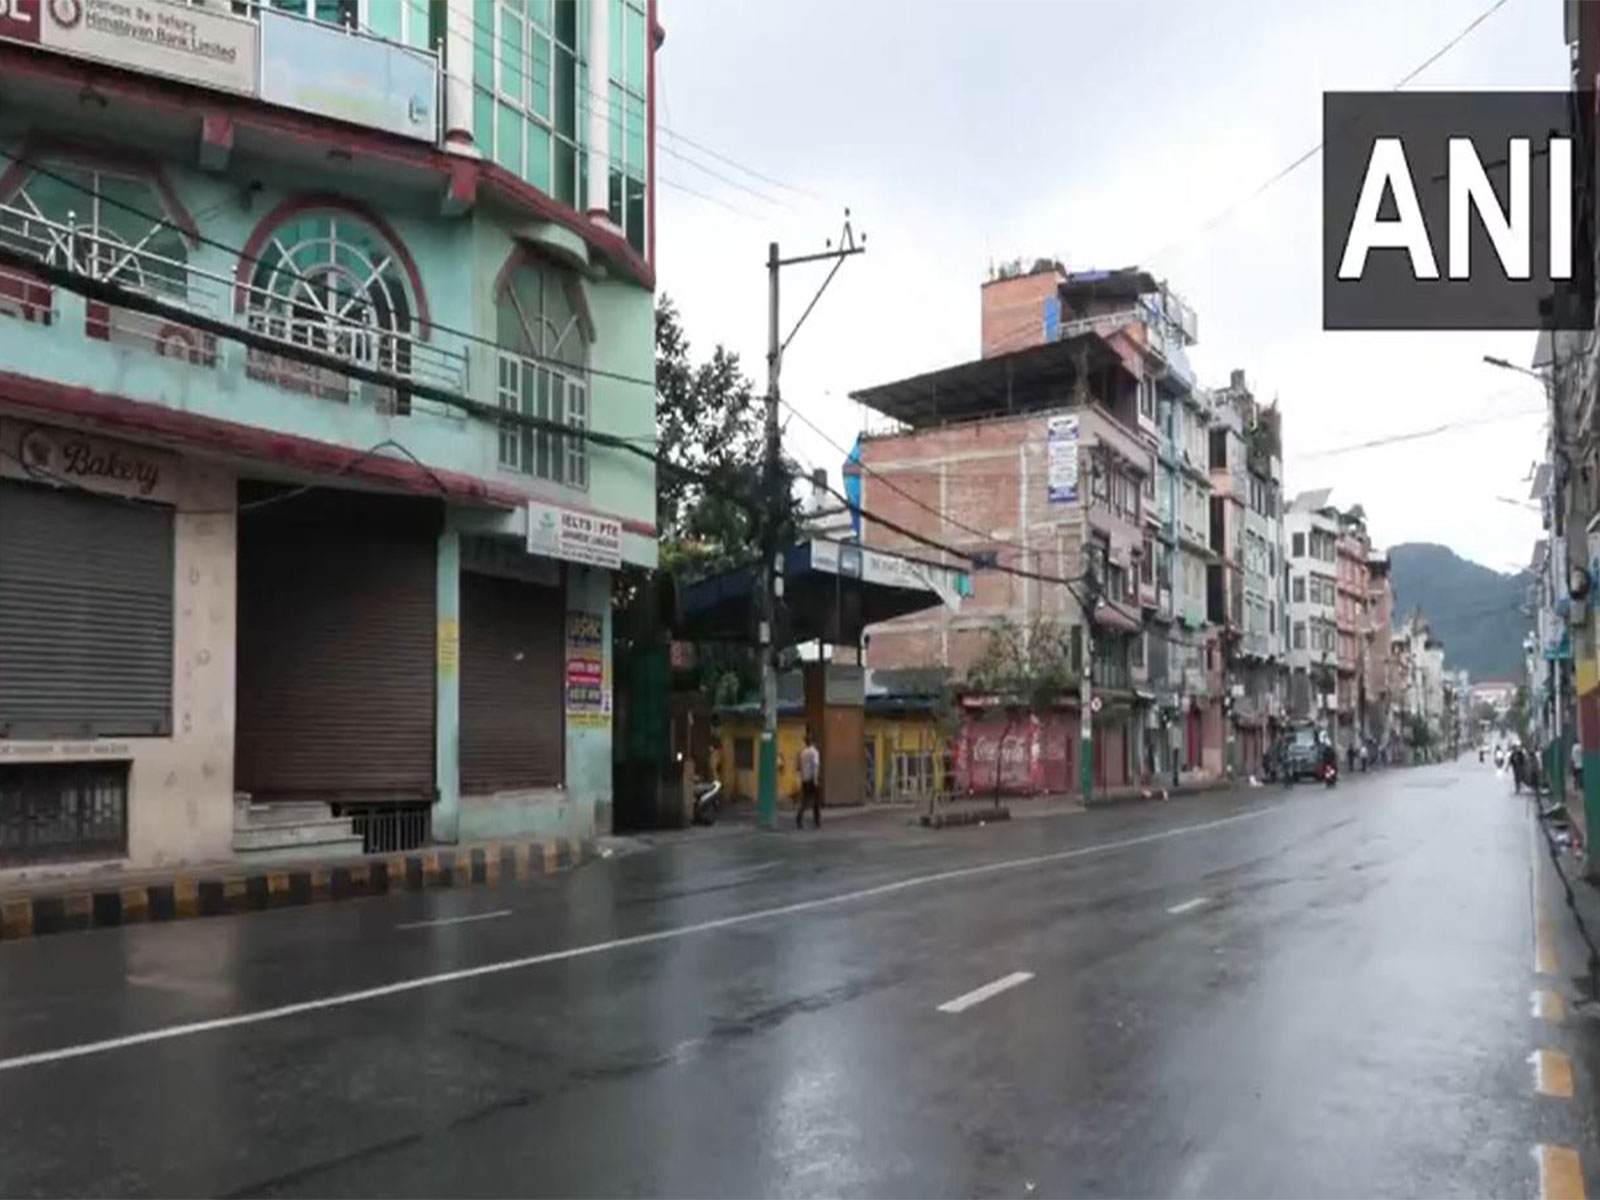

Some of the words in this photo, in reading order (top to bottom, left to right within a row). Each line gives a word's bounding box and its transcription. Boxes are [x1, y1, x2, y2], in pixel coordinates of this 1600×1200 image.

[86, 12, 154, 39] Himalayan
[157, 28, 187, 47] Bank
[190, 33, 237, 61] Limited
[63, 443, 158, 495] Bakery
[561, 513, 592, 531] IELTS
